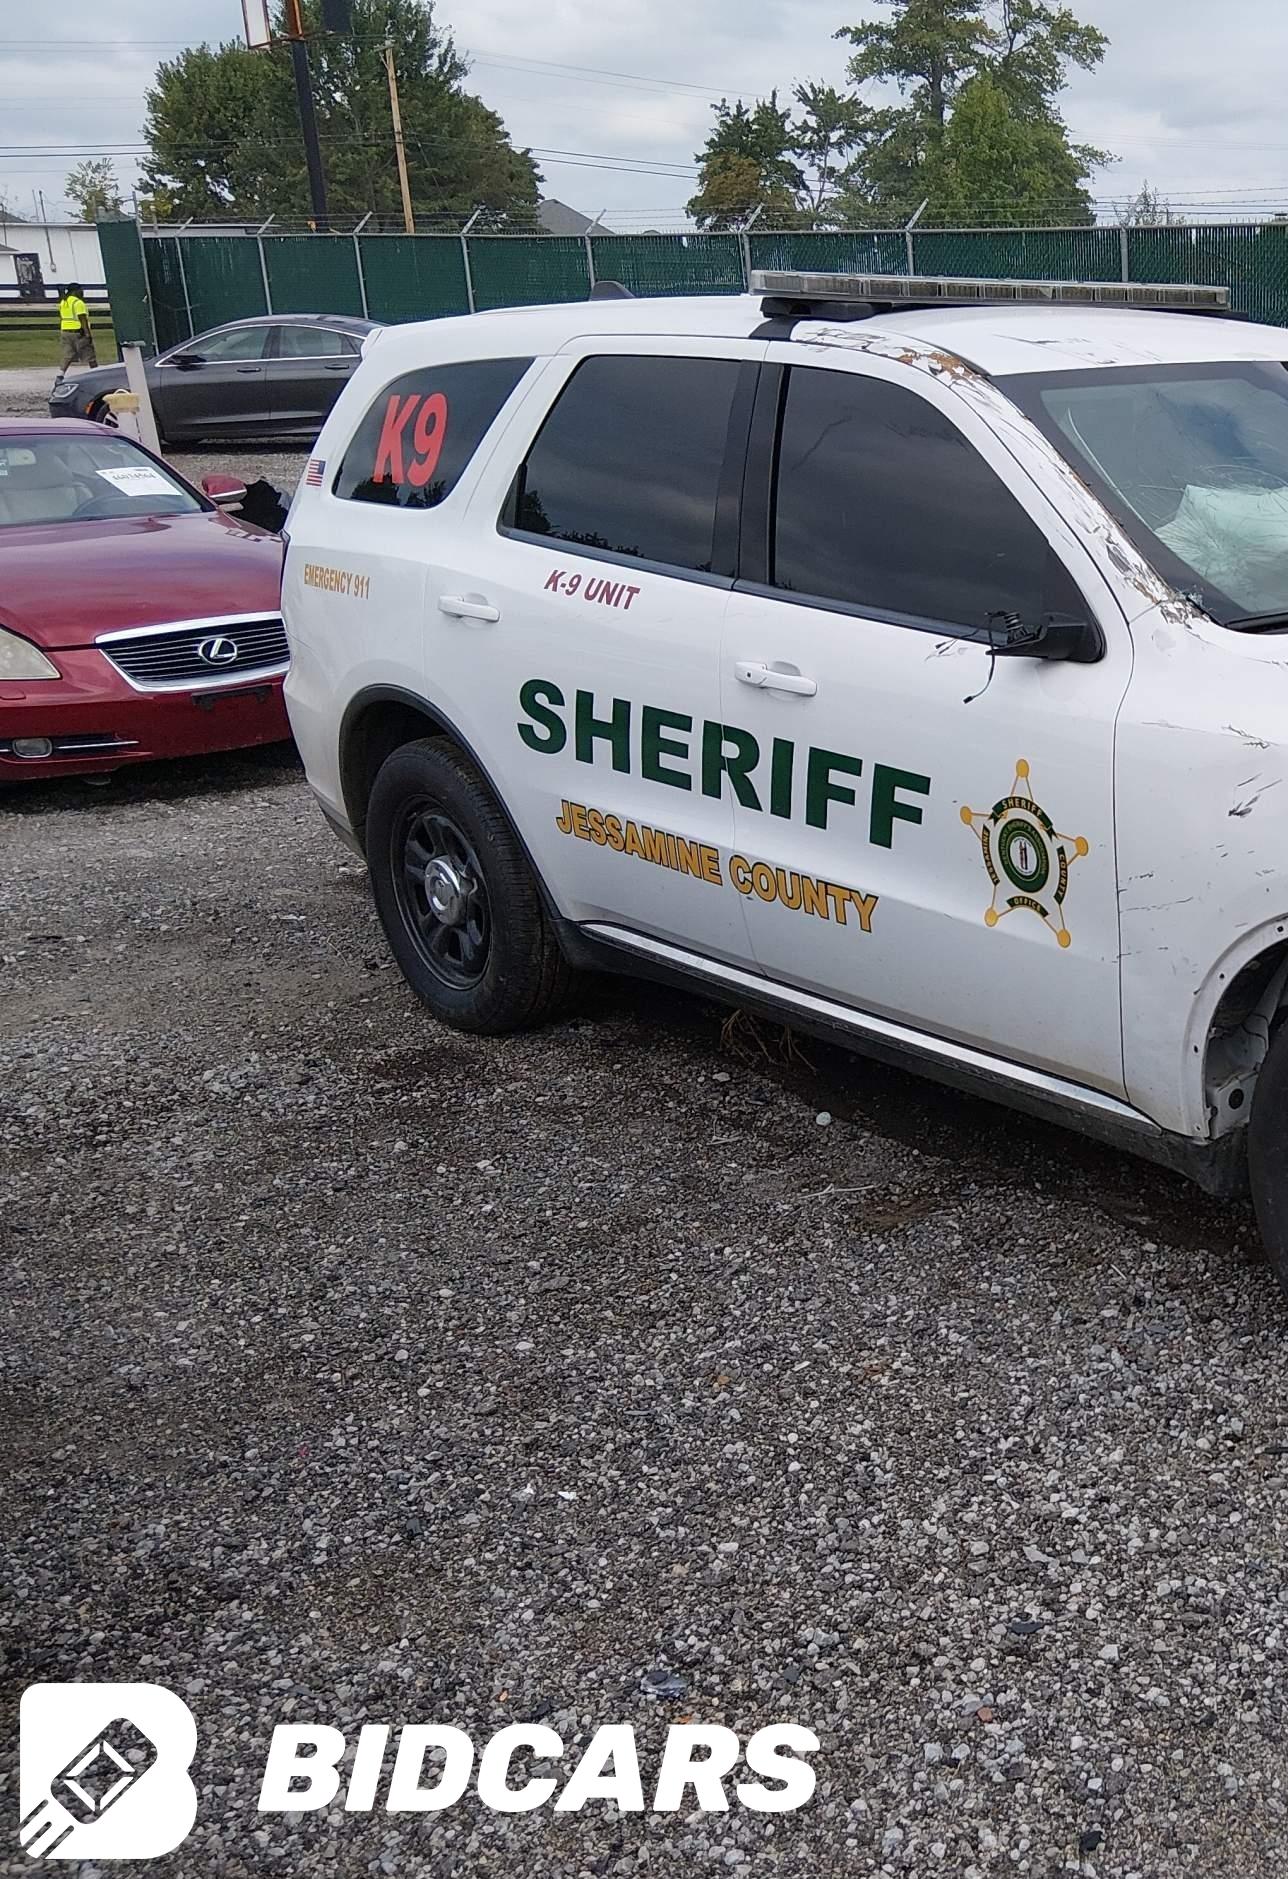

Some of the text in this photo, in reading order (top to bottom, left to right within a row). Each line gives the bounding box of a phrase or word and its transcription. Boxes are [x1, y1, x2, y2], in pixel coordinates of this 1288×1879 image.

[372, 391, 448, 487] K9
[304, 563, 370, 600] EMERGENCY 911
[543, 569, 641, 610] K-9 UNIT
[517, 678, 931, 850] SHERIFF
[1001, 799, 1042, 818] SHERIFF
[555, 799, 879, 933] JESSAMINE COUNTY
[1058, 854, 1067, 896] COUNTY
[1013, 896, 1042, 913] OFFICE
